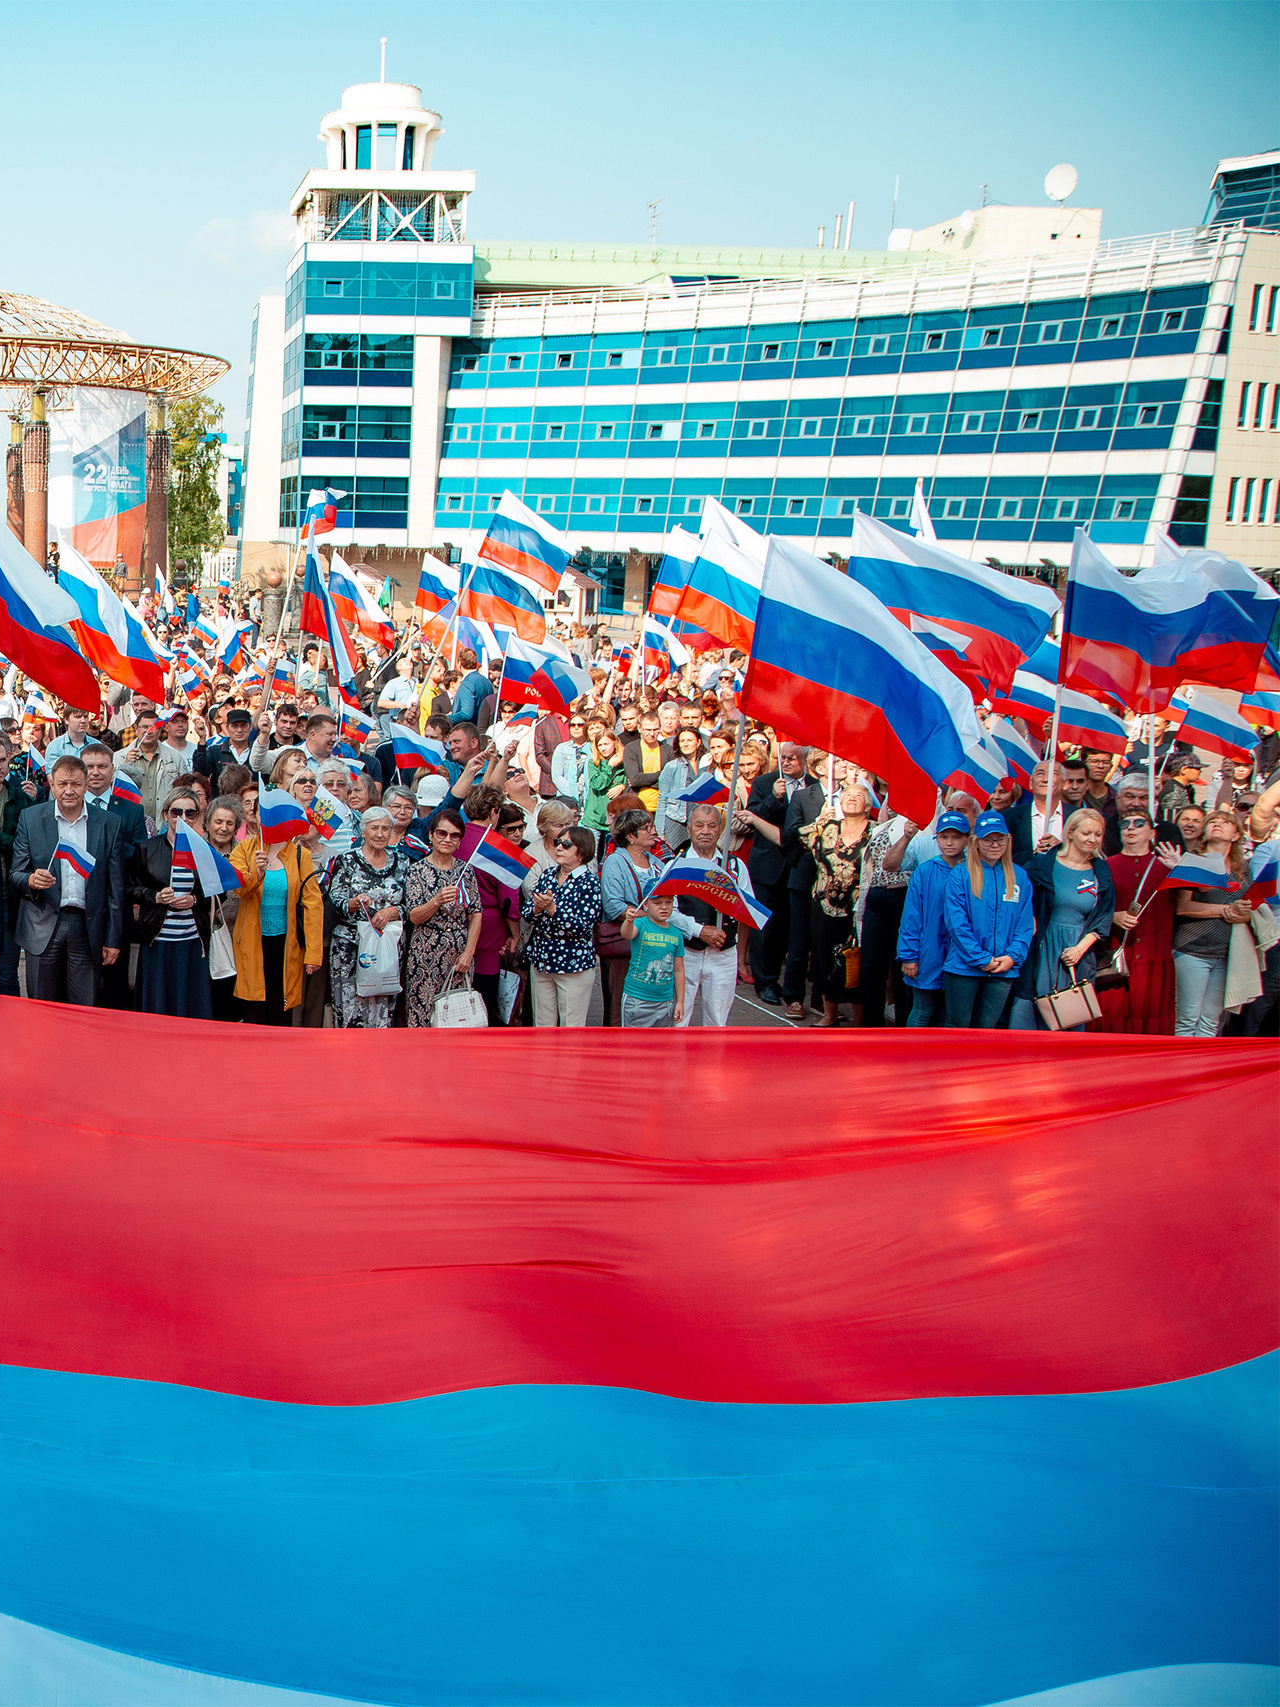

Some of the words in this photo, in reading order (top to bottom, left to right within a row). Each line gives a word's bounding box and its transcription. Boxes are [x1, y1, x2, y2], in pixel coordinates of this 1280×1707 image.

[83, 463, 107, 484] 22
[110, 465, 130, 476] ДЕНЬ
[110, 480, 133, 490] ФЛАГА
[686, 882, 738, 905] РОССИЯ
